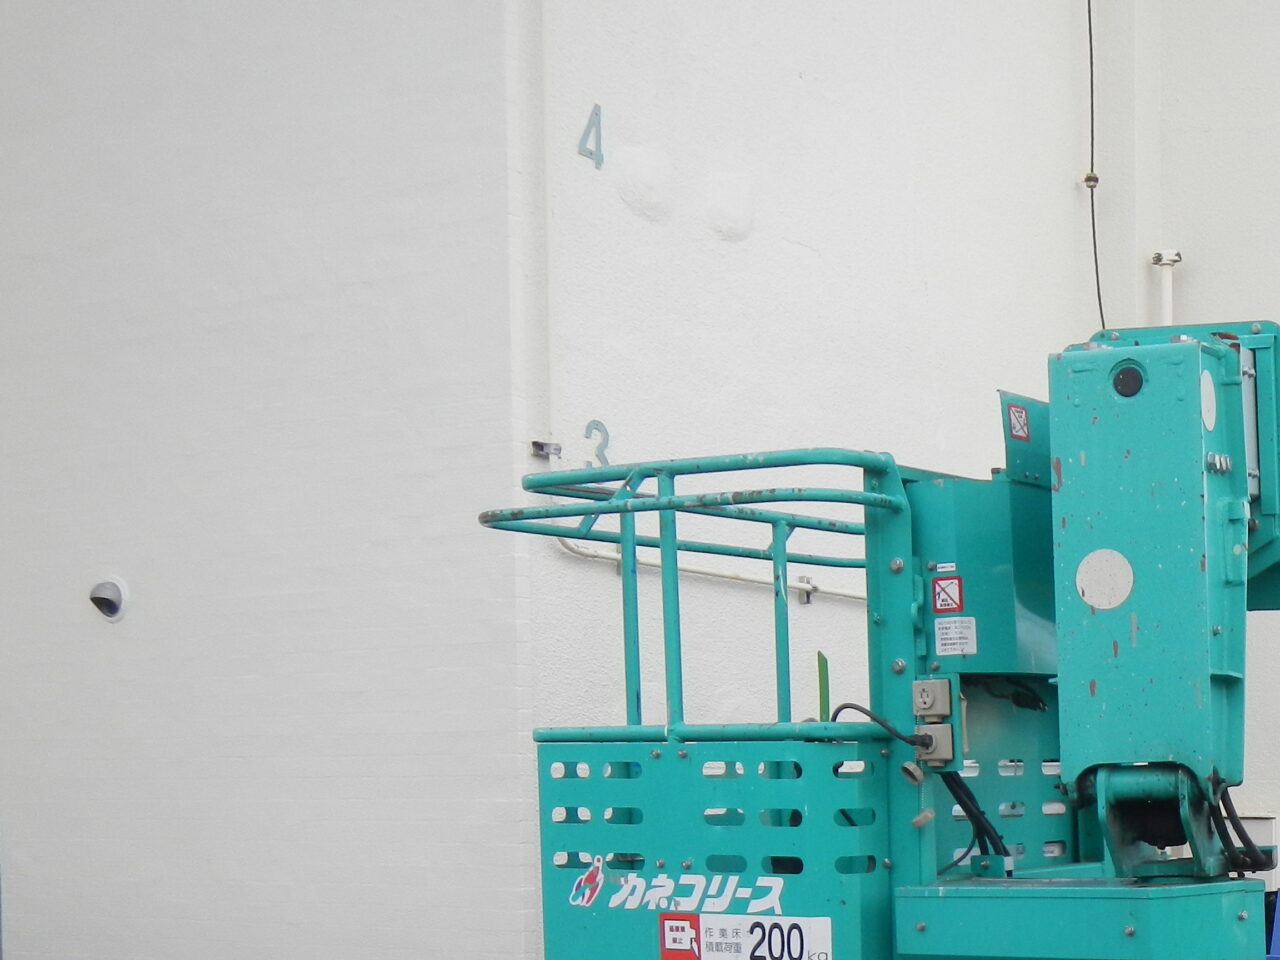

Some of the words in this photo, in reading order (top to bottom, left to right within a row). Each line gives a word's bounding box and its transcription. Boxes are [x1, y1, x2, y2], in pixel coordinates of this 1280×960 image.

[578, 103, 604, 170] 4
[608, 873, 785, 915] カネコリース
